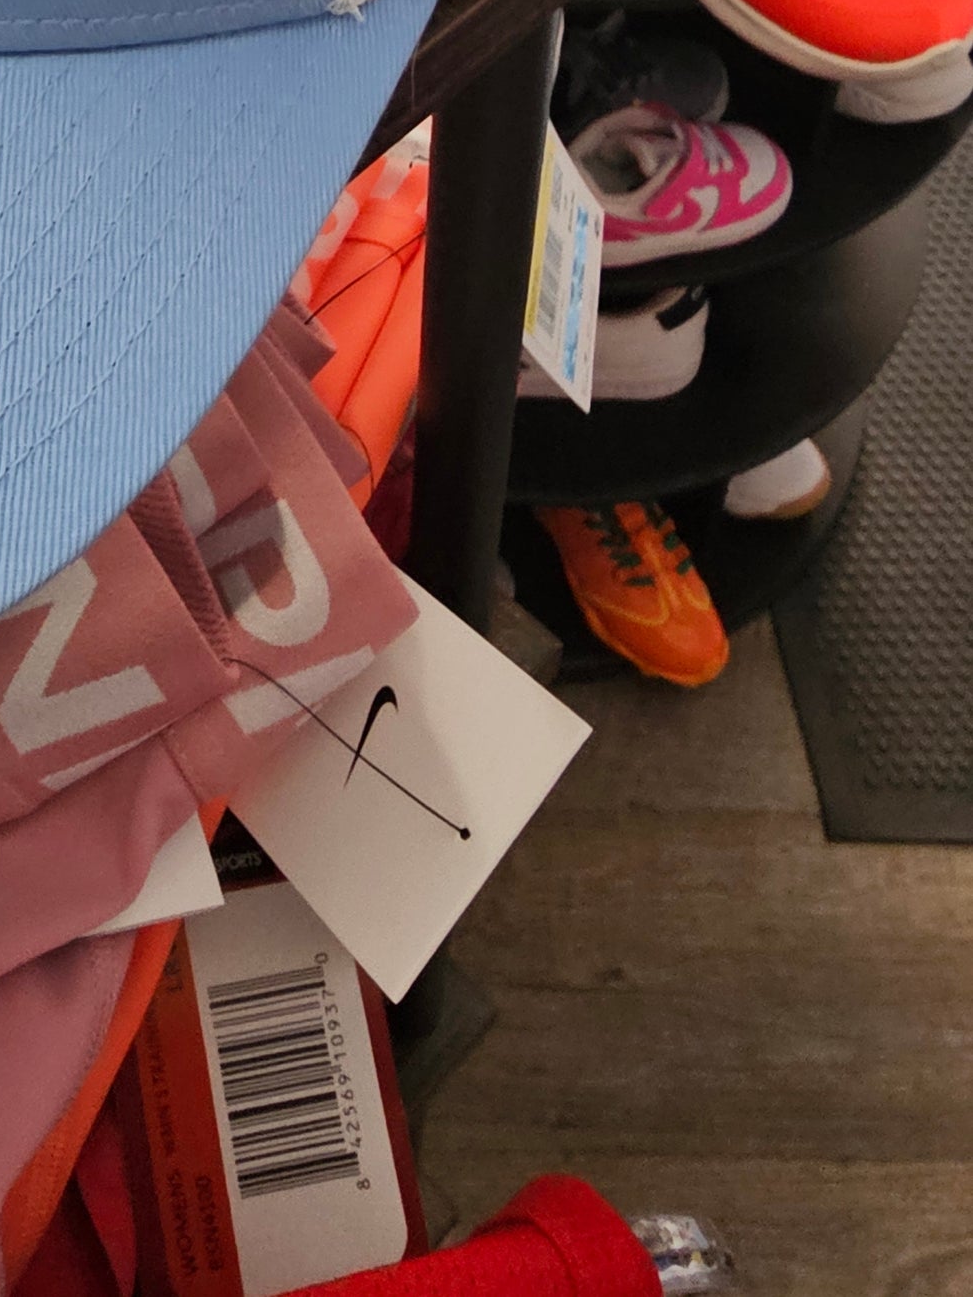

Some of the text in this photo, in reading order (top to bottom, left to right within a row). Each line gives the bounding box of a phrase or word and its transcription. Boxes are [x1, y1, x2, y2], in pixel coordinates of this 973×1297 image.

[314, 952, 371, 1192] 8 42569 10937 0
